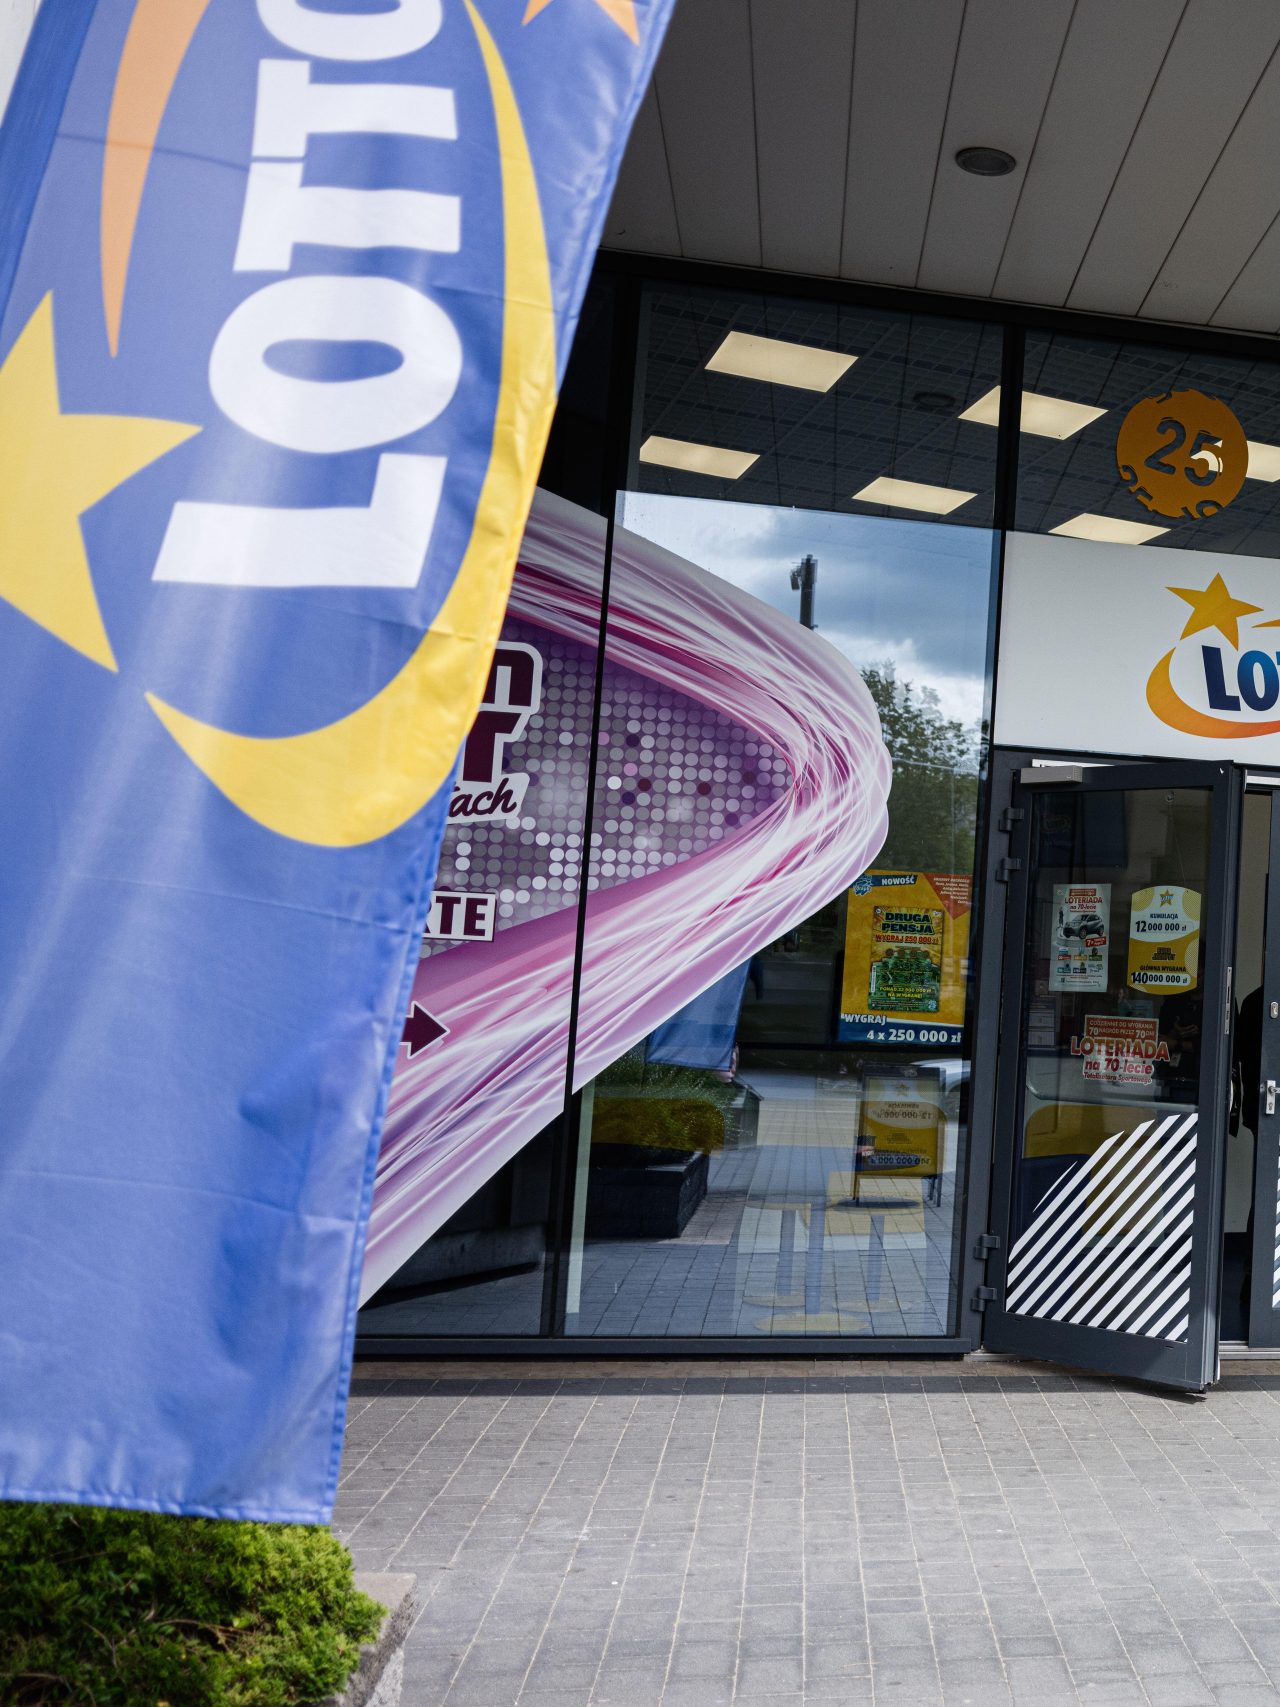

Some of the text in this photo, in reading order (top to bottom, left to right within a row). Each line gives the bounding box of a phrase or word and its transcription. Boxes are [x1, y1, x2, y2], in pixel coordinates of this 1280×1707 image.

[152, 0, 463, 589] LOTTO
[1144, 419, 1223, 487] 25
[447, 777, 518, 818] ach
[881, 875, 915, 885] NOWOŚĆ
[1065, 896, 1103, 904] LOTERIADA
[885, 912, 931, 922] DRUGA
[881, 923, 934, 933] PENSJA
[1165, 923, 1180, 931] 000
[875, 934, 904, 943] WYGRAJ
[1166, 974, 1181, 983] 000
[844, 1014, 887, 1025] WYGRAJ
[867, 1029, 961, 1043] 4 x 250 000 zł
[1089, 1027, 1099, 1035] 70
[1135, 1030, 1146, 1038] 70
[1071, 1036, 1170, 1062] LOTERIADA
[1084, 1058, 1153, 1074] na 70-lecie
